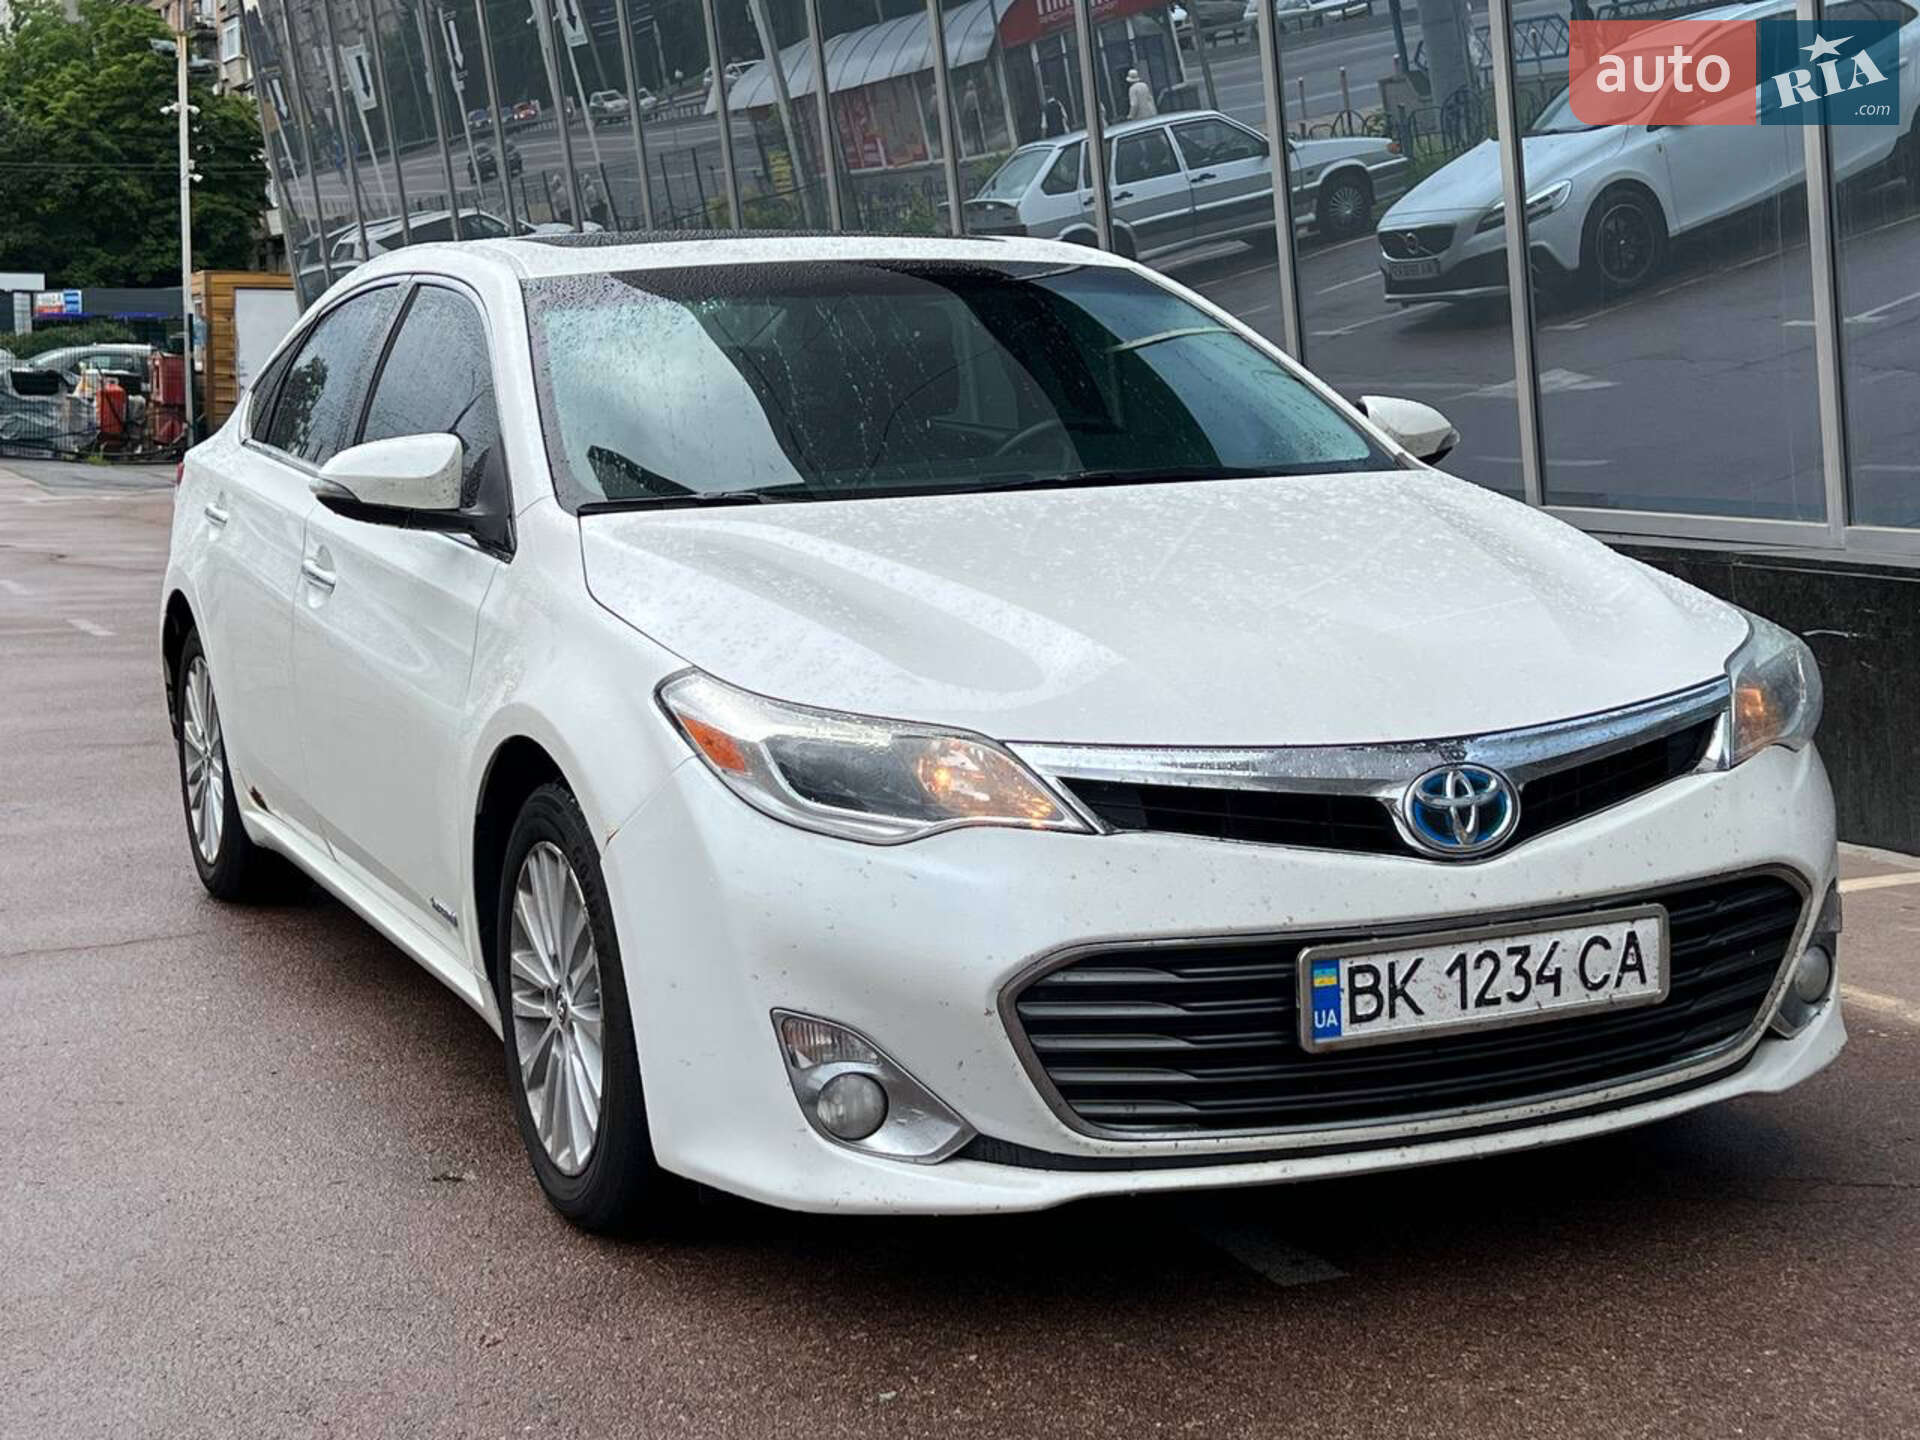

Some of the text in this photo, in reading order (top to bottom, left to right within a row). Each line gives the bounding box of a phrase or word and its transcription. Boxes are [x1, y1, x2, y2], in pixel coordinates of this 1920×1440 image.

[1348, 930, 1648, 1024] BK 1234 CA
[1314, 1013, 1338, 1028] UA
